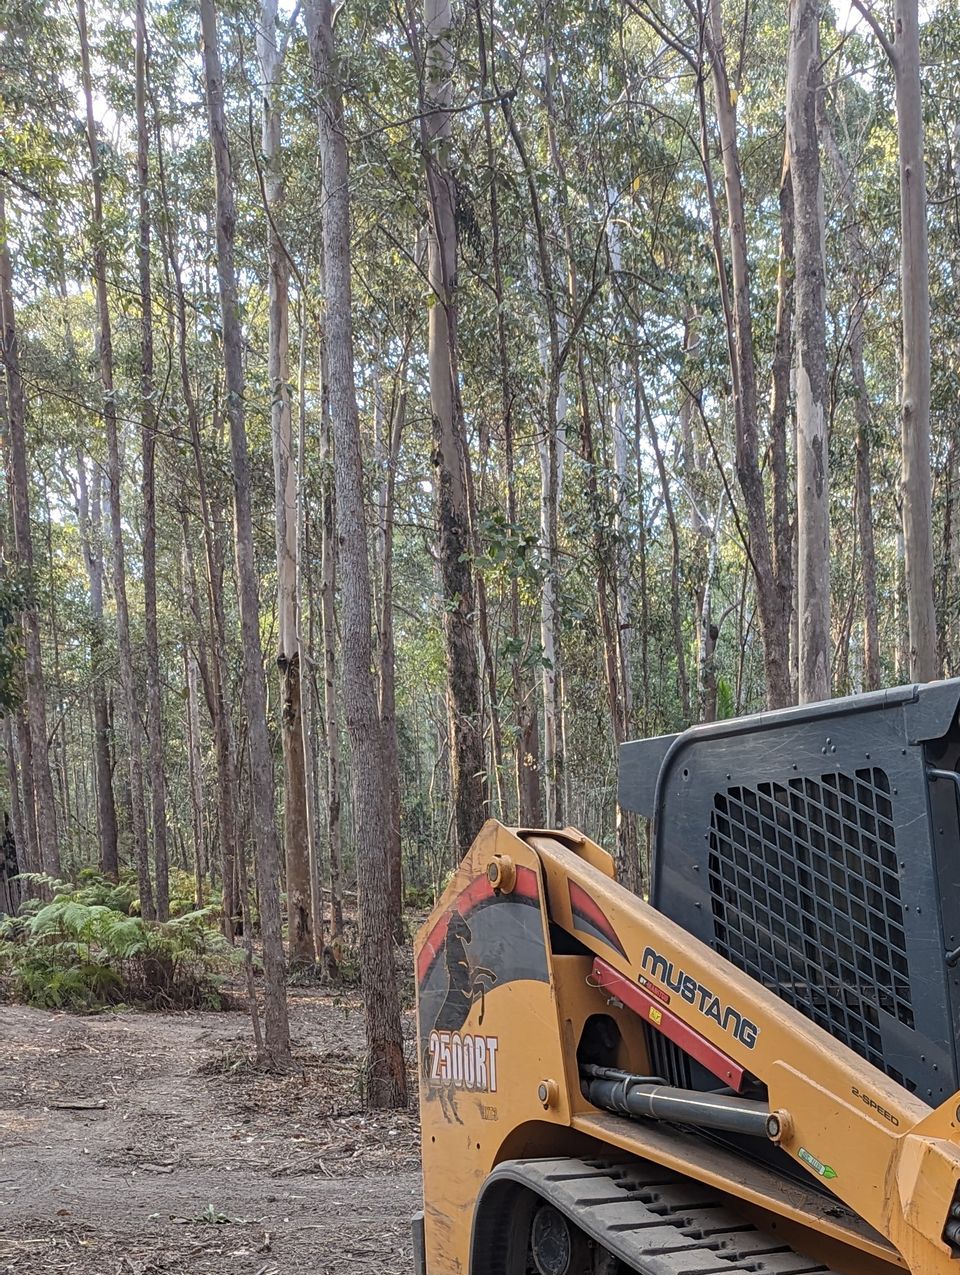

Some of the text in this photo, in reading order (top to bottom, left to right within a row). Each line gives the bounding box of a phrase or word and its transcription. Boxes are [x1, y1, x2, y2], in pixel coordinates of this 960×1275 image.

[640, 945, 759, 1051] MUSTANG
[428, 1029, 499, 1094] 2500RT
[851, 1086, 900, 1127] 2-SPEED
